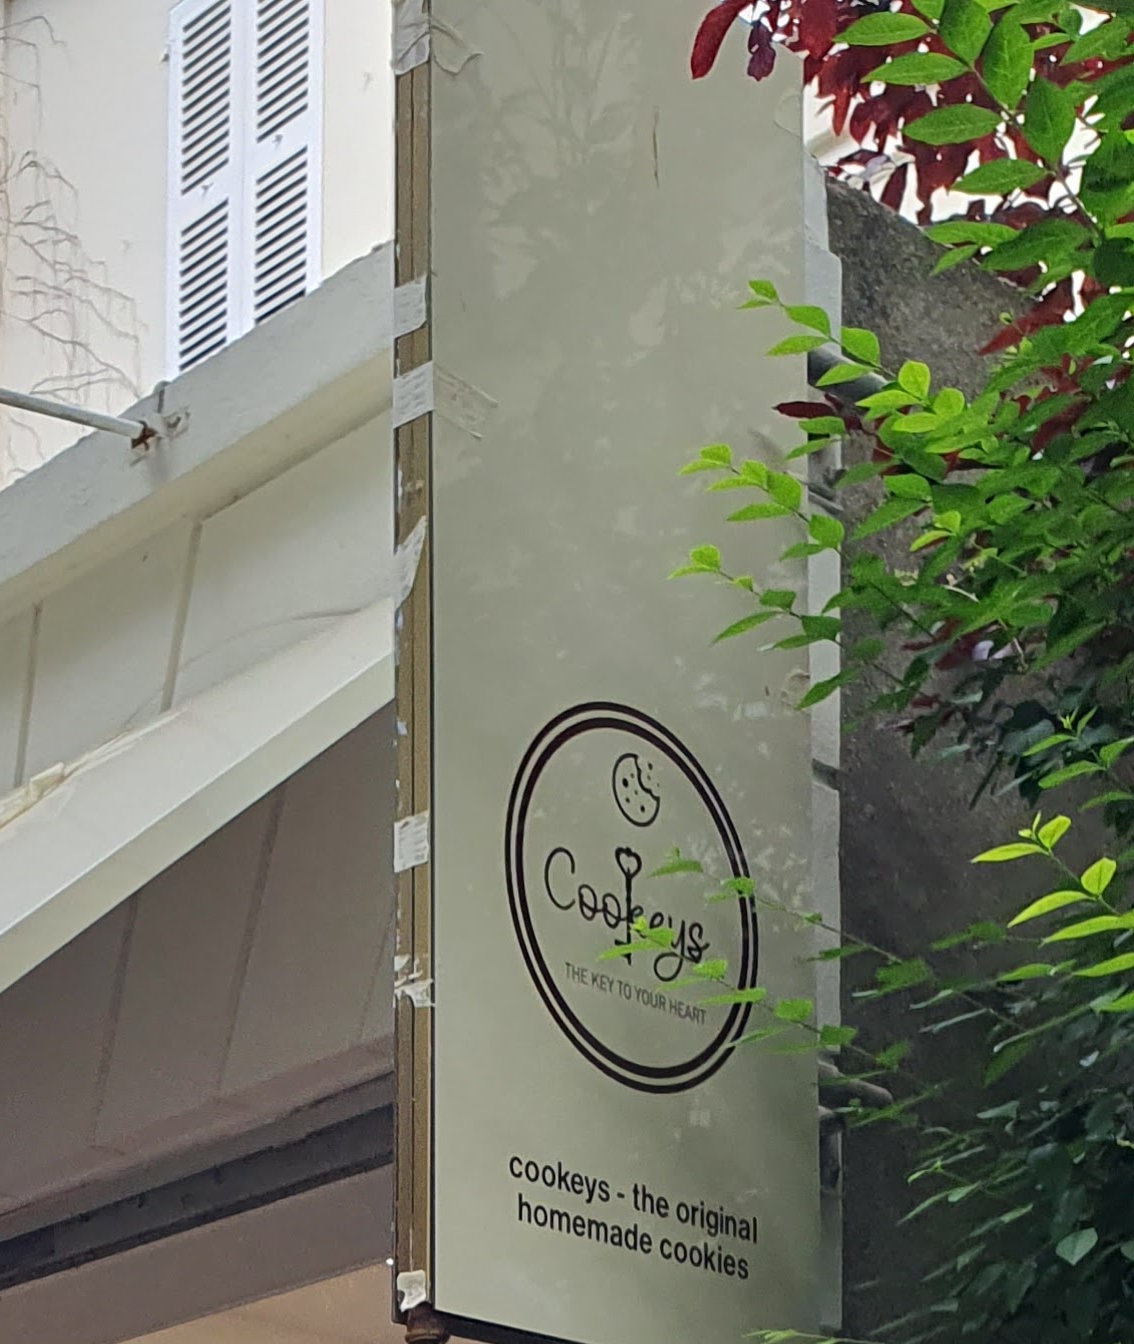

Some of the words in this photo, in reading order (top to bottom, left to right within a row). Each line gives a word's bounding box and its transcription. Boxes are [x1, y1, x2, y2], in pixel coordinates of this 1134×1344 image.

[565, 961, 588, 985] THE
[591, 972, 615, 993] KEY
[617, 980, 632, 1001] TO
[633, 986, 666, 1013] YOUR
[668, 999, 707, 1026] HEART
[509, 1156, 610, 1204] cookeys
[632, 1183, 669, 1219] the
[676, 1200, 758, 1244] original
[517, 1193, 653, 1255] homemade
[659, 1238, 749, 1280] cookies
